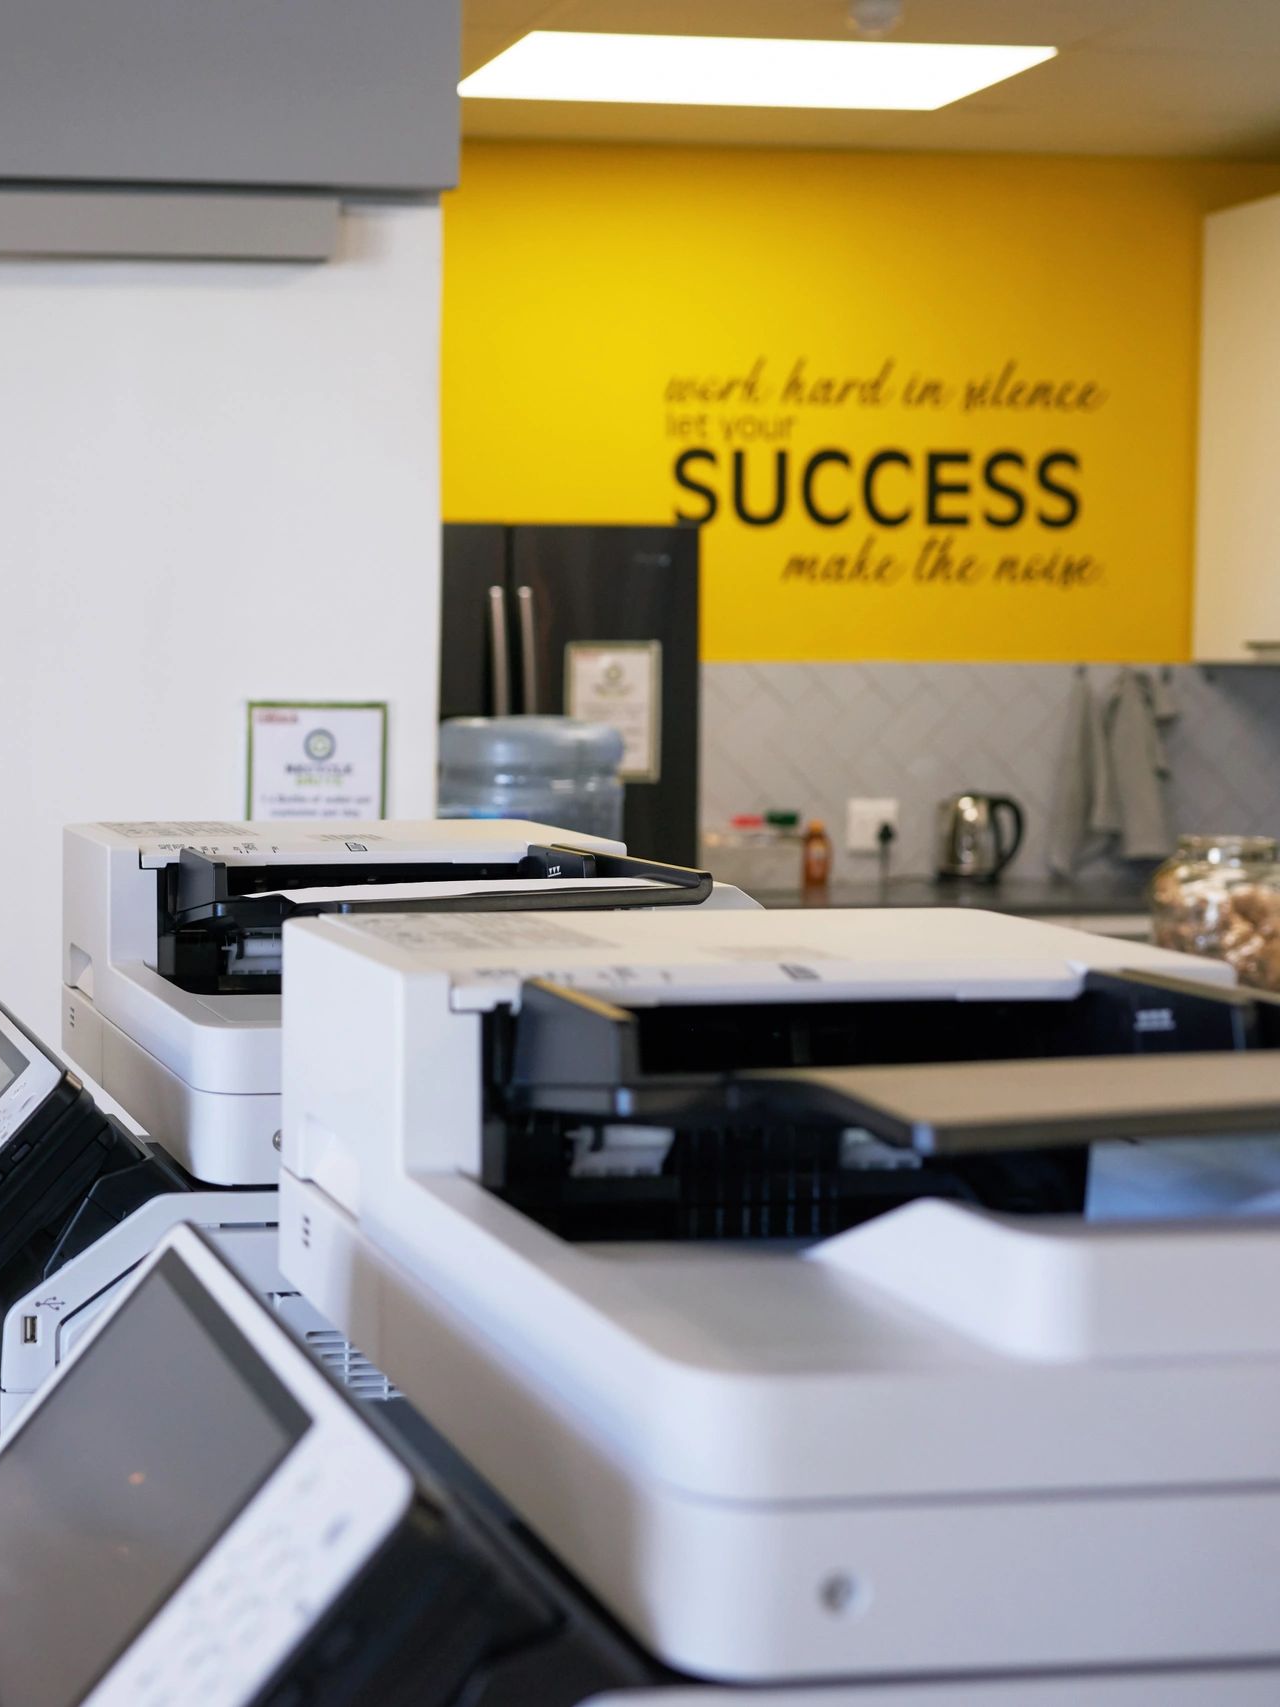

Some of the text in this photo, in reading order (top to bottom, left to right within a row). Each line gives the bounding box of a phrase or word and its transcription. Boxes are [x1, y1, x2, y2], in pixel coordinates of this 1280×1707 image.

[664, 357, 1108, 413] work hard in silence
[665, 412, 794, 443] let your
[672, 447, 1083, 529] SUCCESS
[782, 535, 1104, 588] make the noise
